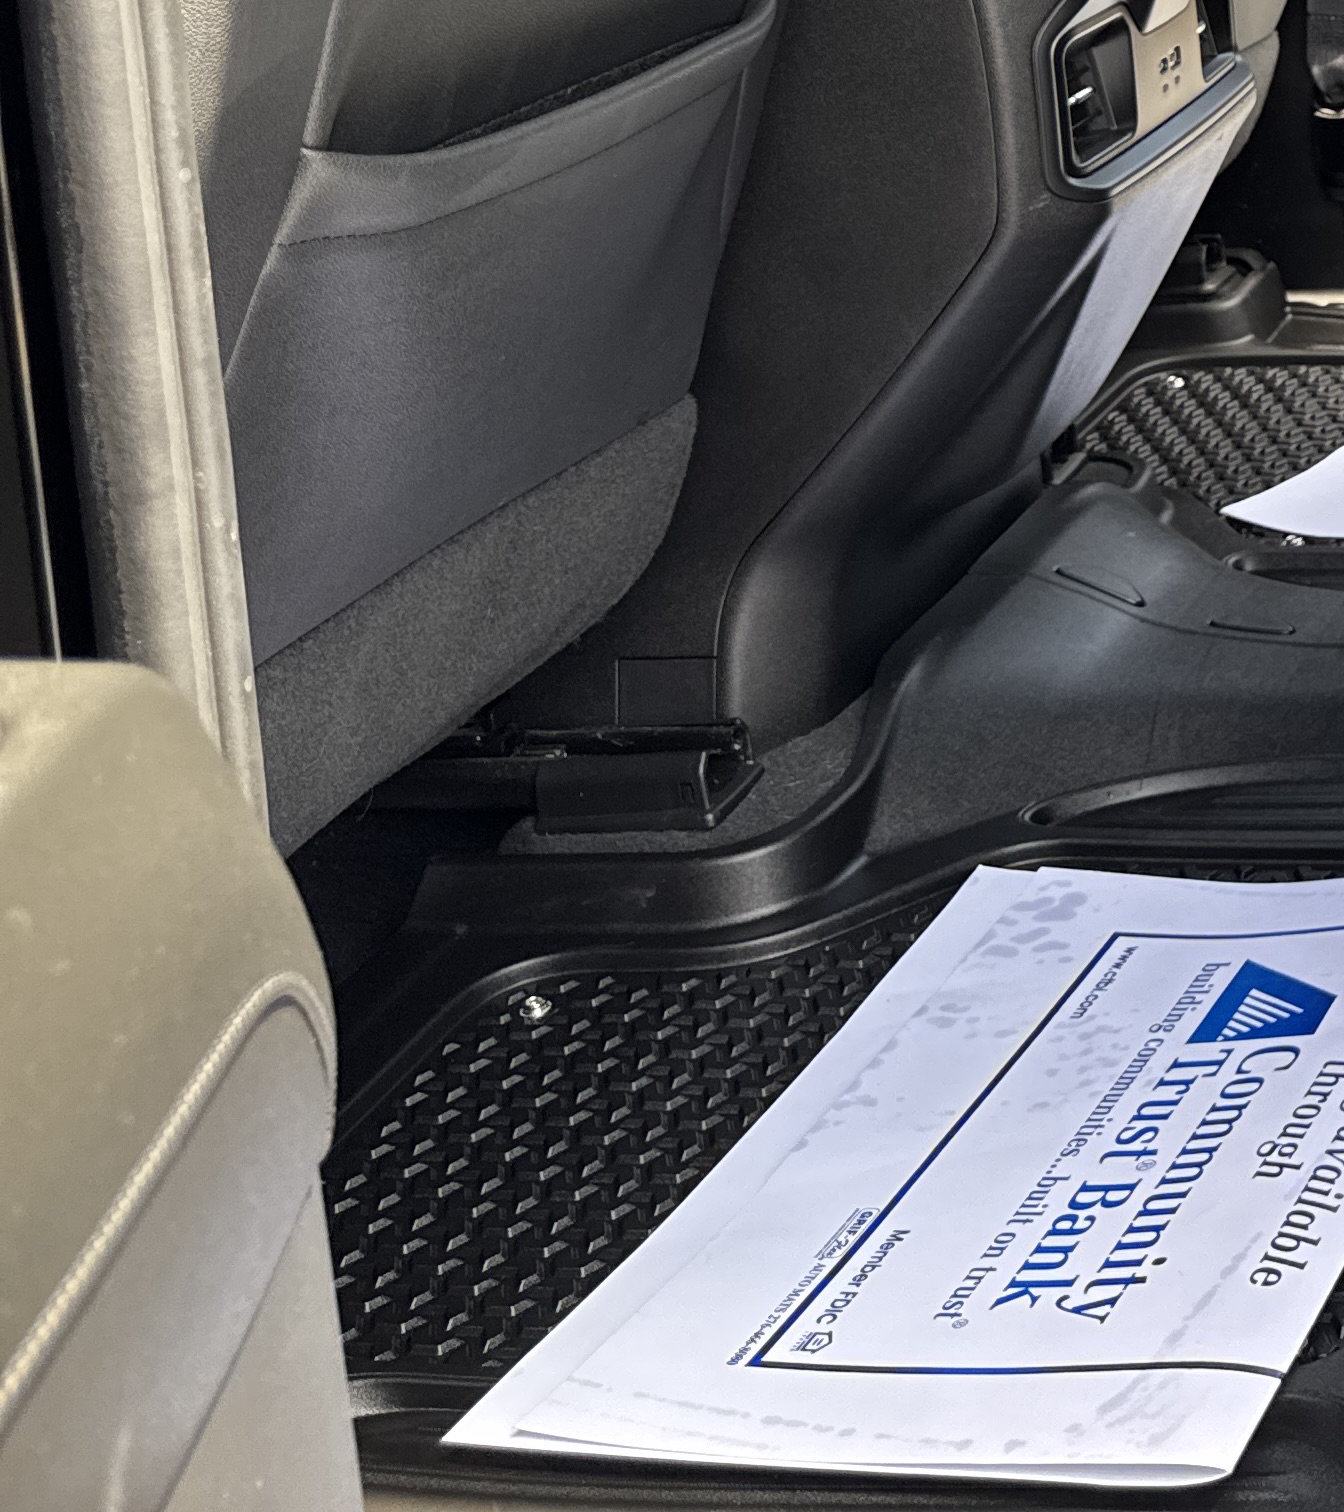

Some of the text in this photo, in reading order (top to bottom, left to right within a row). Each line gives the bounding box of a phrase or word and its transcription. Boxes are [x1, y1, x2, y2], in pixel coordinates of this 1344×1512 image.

[1148, 961, 1231, 1034] building
[1055, 1044, 1301, 1324] Community
[798, 1262, 826, 1288] AUTO
[815, 1229, 911, 1325] Member FDIC
[980, 1232, 1016, 1259] on
[989, 1178, 1143, 1310] Bank
[774, 1288, 805, 1314] MATS
